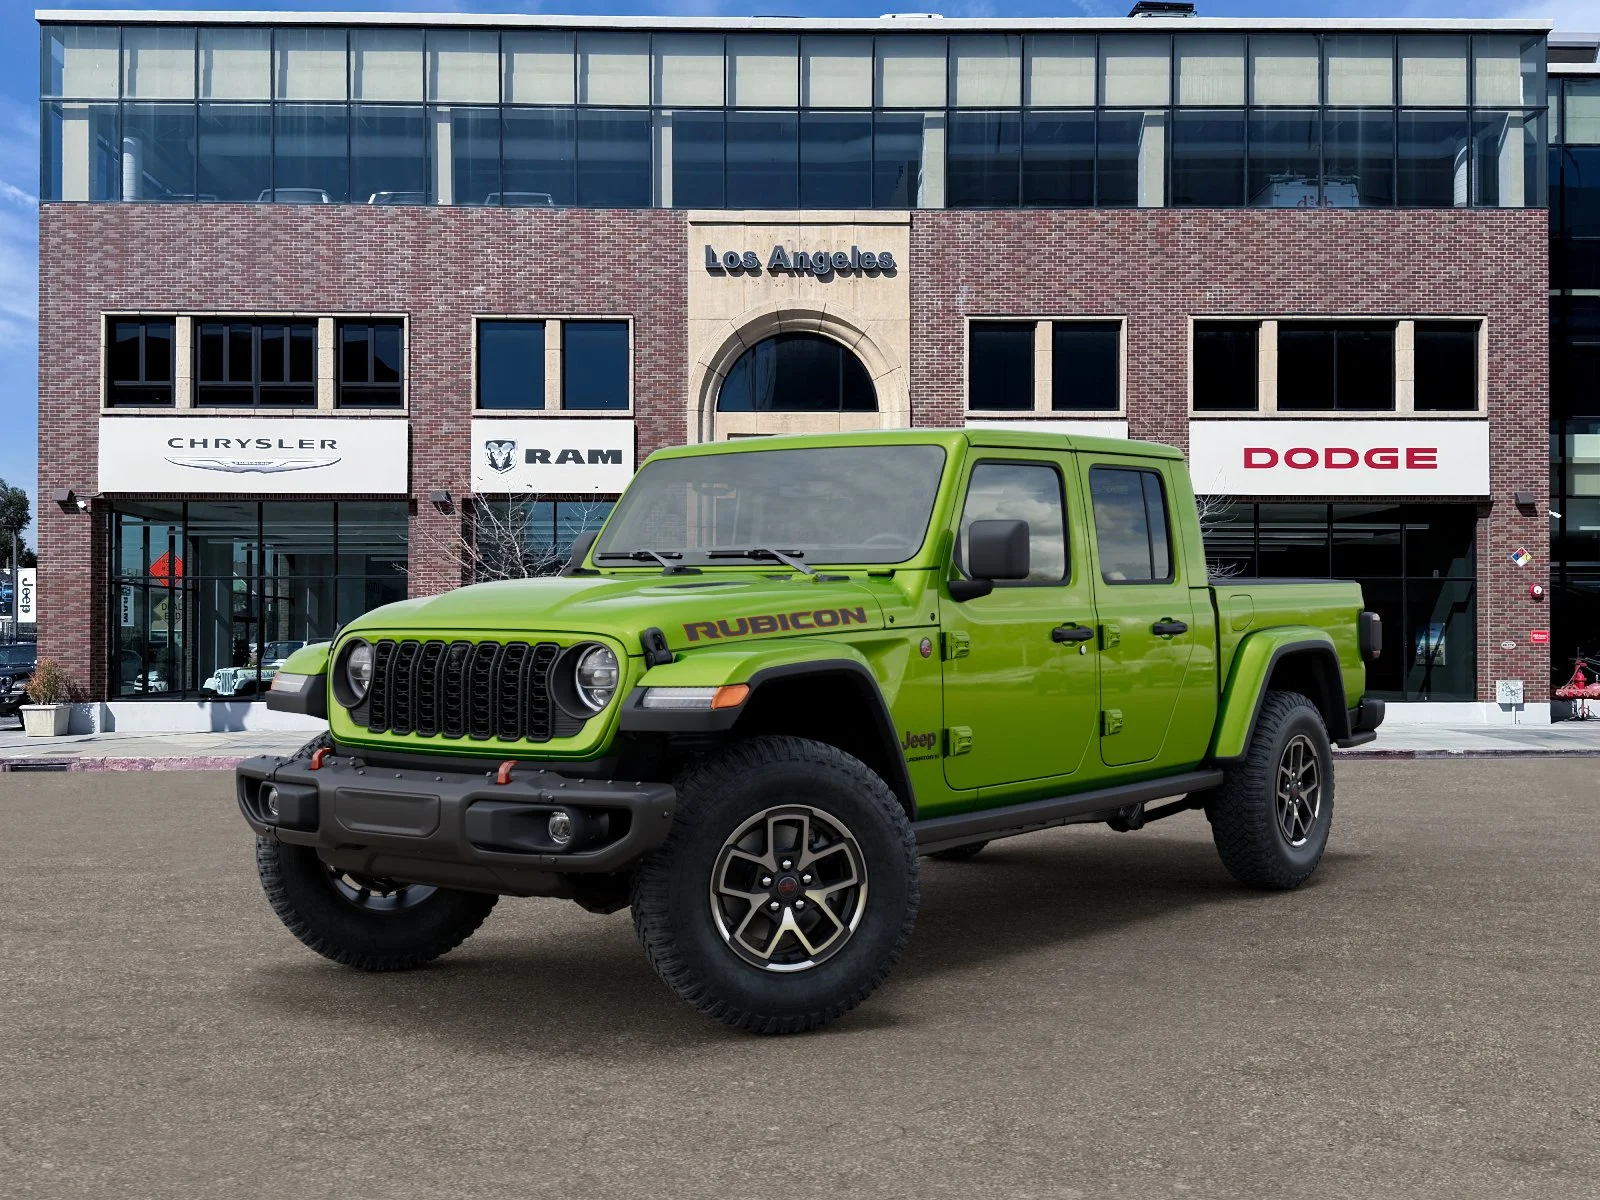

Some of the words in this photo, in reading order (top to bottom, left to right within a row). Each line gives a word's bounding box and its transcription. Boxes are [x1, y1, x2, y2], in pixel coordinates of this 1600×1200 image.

[704, 244, 759, 270] Los
[767, 245, 895, 276] Angeles
[167, 437, 338, 450] CHRYSLER
[524, 448, 623, 465] RAM
[1243, 447, 1438, 470] DODGE
[20, 577, 33, 614] Jeep
[164, 612, 181, 620] ED
[683, 606, 868, 642] RUBICON
[902, 730, 937, 751] Jeep
